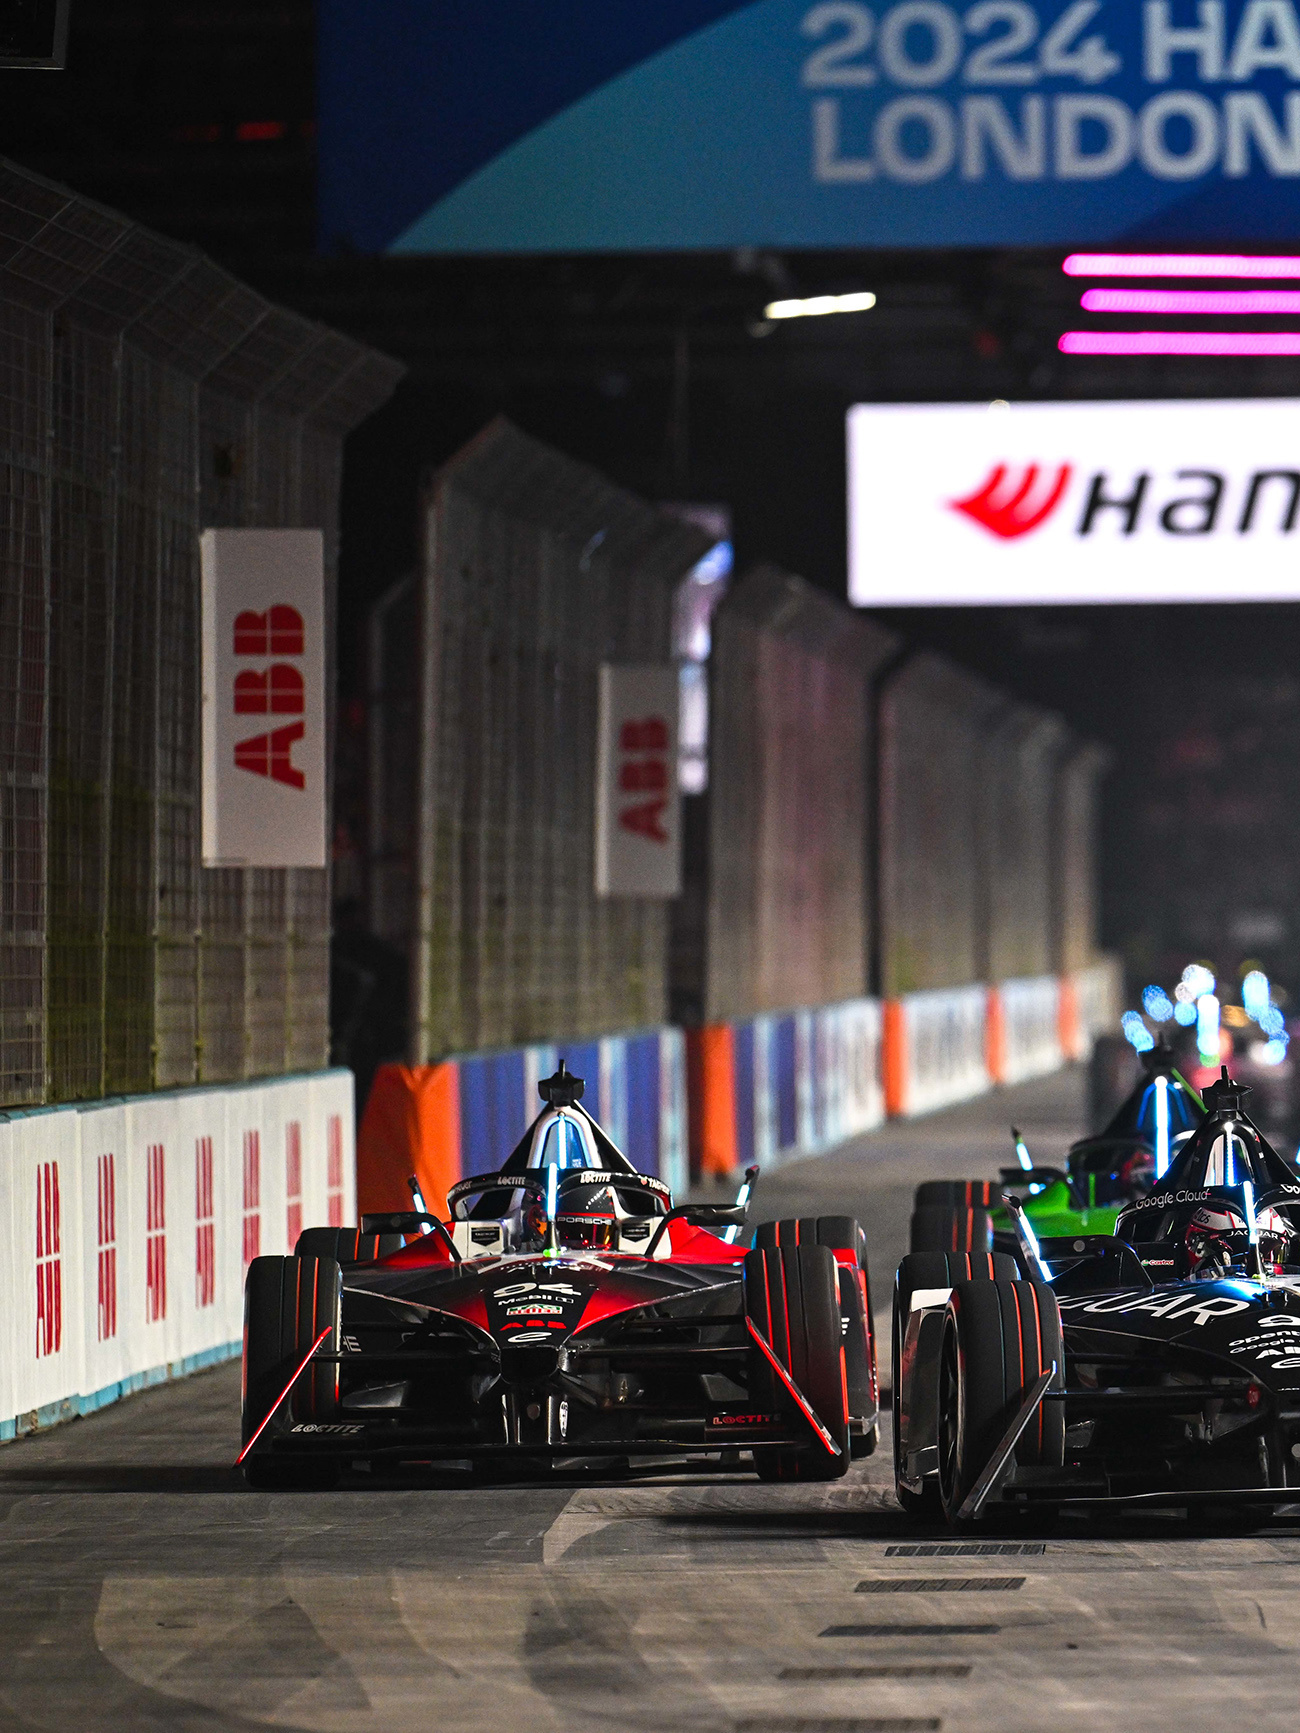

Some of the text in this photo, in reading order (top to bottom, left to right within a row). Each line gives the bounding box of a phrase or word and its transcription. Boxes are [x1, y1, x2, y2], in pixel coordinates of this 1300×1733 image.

[802, 0, 1122, 86] 2024
[233, 604, 305, 790] ABB
[617, 717, 669, 846] ABB
[1135, 1187, 1210, 1210] Google Cloud
[557, 1216, 612, 1226] PORSCHE
[499, 1319, 568, 1332] ABB
[290, 1423, 365, 1434] LOCTITE
